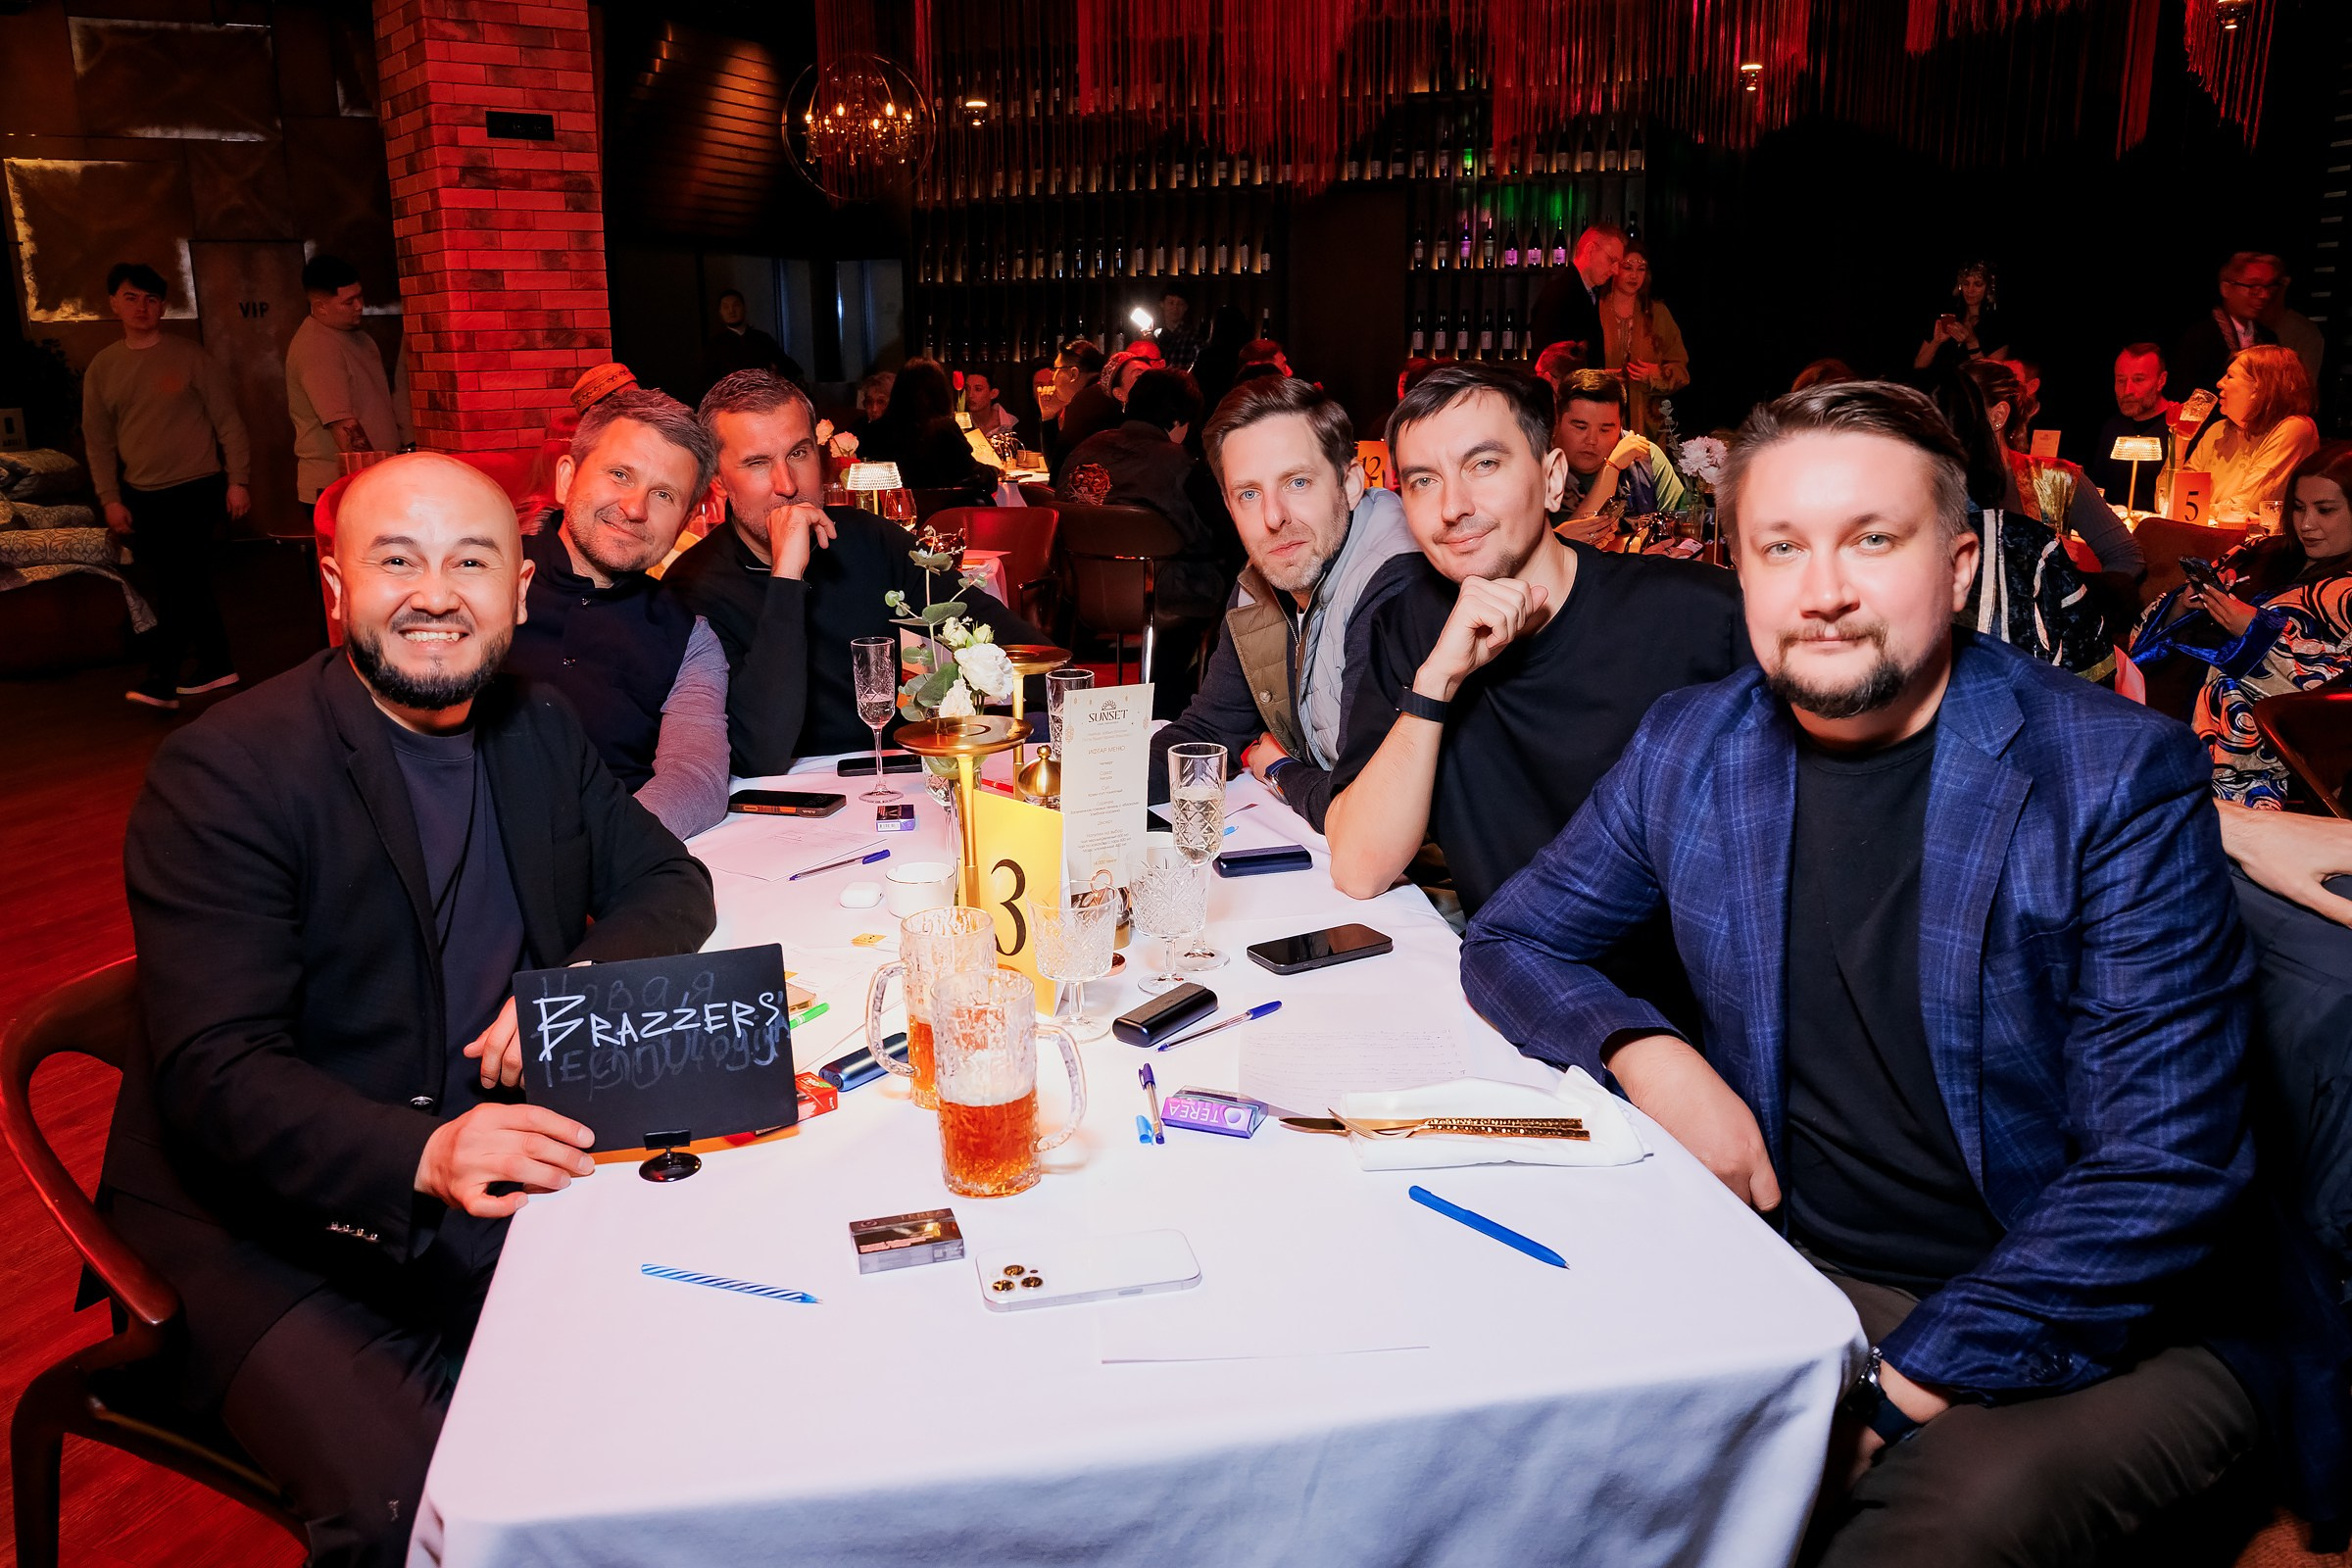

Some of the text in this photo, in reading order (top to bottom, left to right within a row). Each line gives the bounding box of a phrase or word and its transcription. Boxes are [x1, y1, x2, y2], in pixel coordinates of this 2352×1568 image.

[239, 302, 270, 318] VIP
[1362, 456, 1381, 480] 12
[2184, 491, 2199, 521] 5
[1088, 709, 1128, 723] SUNSET
[991, 858, 1026, 956] 3
[1169, 1102, 1219, 1123] TEREA
